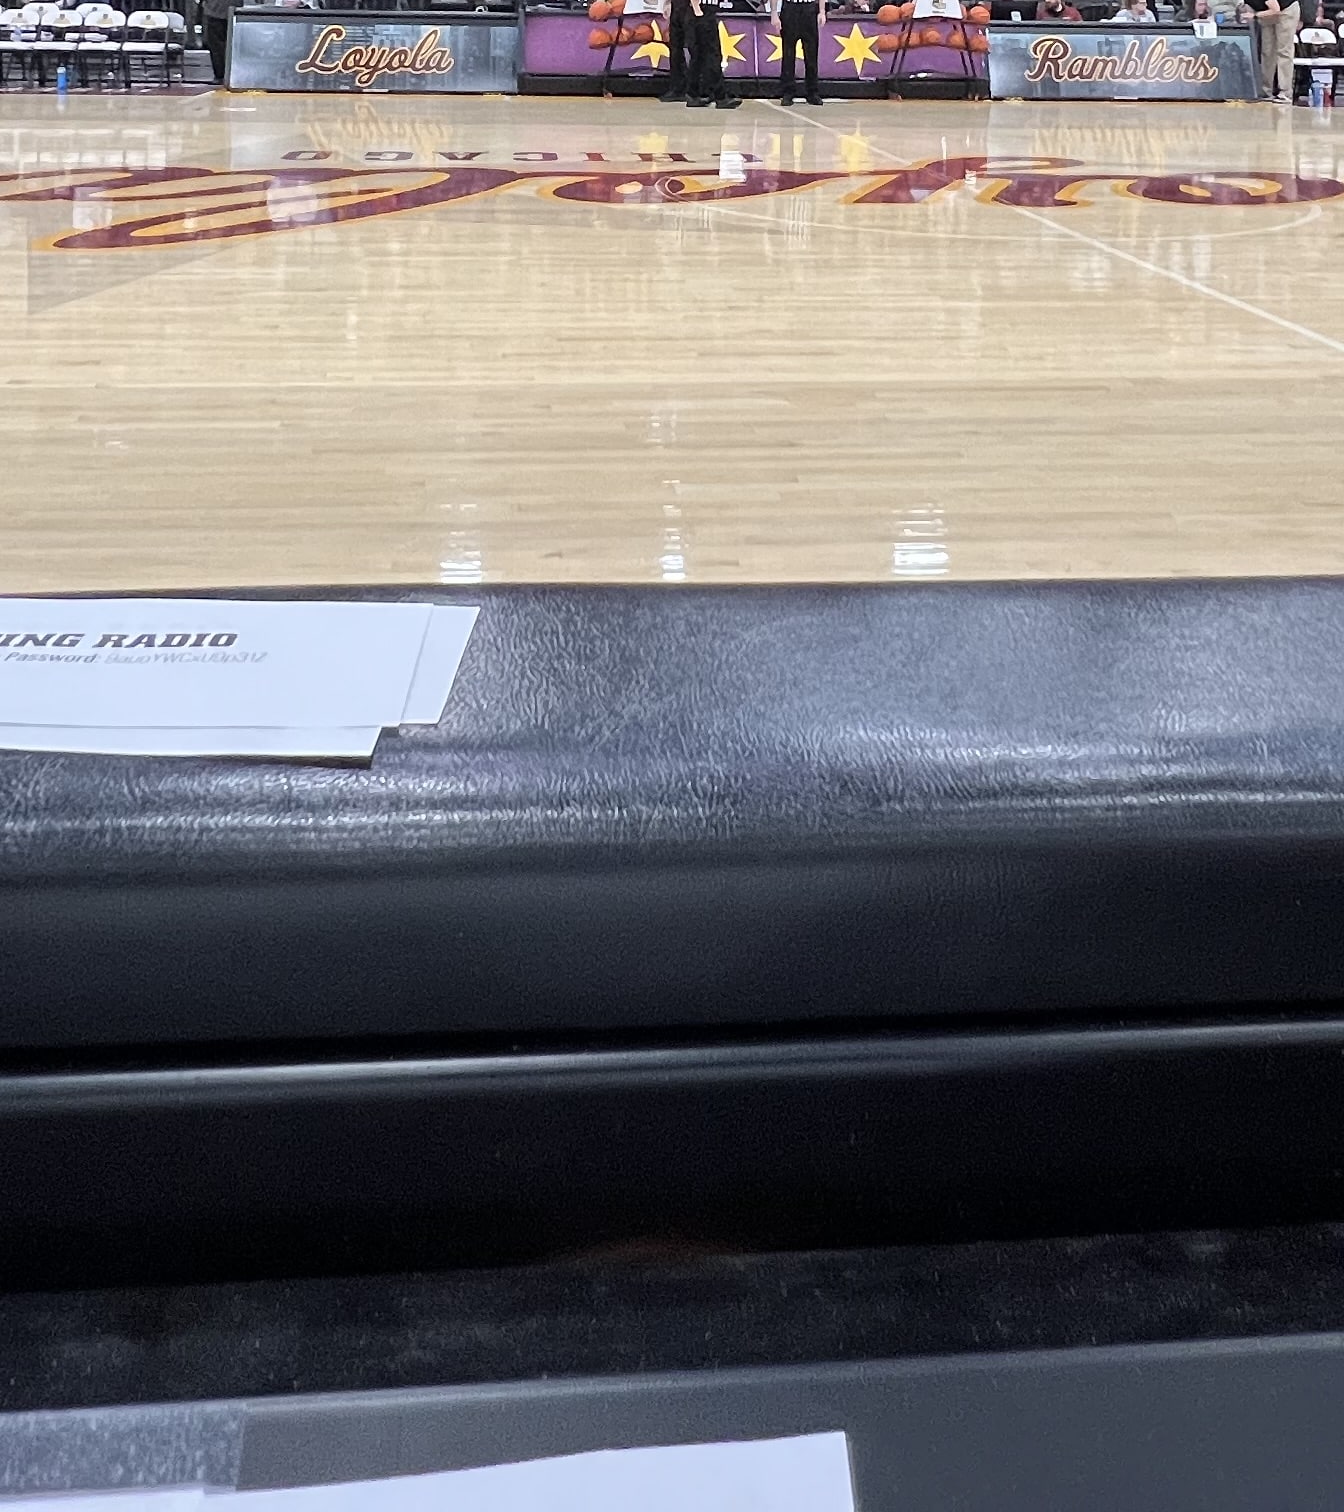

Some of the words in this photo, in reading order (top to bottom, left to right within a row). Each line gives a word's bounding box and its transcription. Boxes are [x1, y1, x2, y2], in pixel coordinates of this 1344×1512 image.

[296, 24, 454, 87] Loyola
[1024, 35, 1219, 83] Ramblers
[92, 632, 239, 649] RADIO
